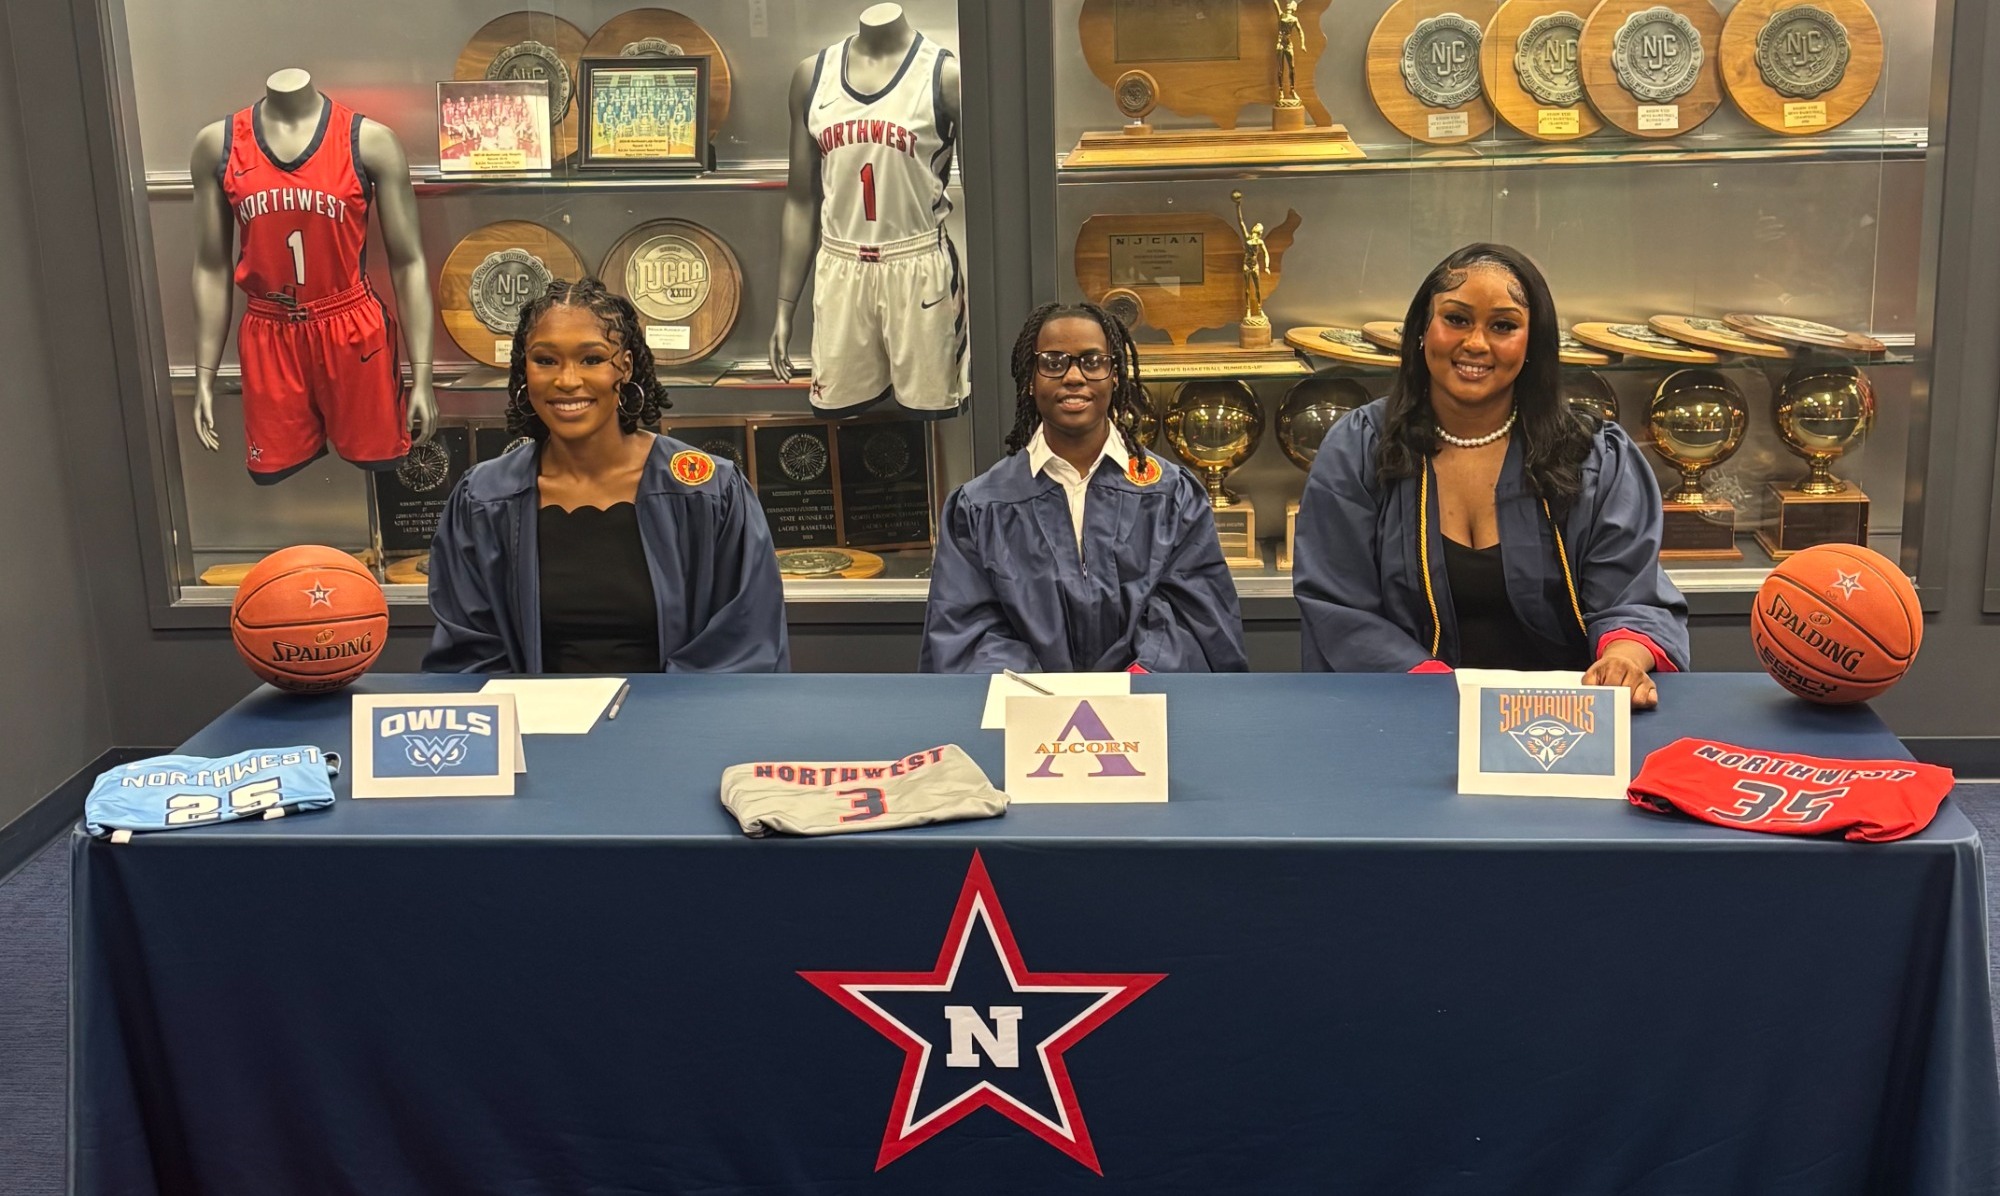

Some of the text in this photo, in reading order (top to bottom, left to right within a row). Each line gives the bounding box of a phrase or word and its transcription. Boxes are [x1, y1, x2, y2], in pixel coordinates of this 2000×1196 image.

[817, 119, 918, 160] NORTHWEST
[238, 187, 346, 225] NORTHWEST
[860, 162, 877, 222] 1
[286, 229, 306, 286] 1
[637, 260, 704, 295] NJCAA
[670, 287, 692, 298] XXIII
[271, 631, 373, 663] SPALDING
[1765, 593, 1865, 675] SPALDING
[1756, 632, 1838, 695] LEGACY
[380, 708, 492, 738] OWLS
[1499, 693, 1595, 734] SKYHAWKS
[120, 748, 319, 788] NORTHWEST
[754, 746, 945, 787] NORTHWEST
[1034, 741, 1140, 754] ALCORN
[165, 776, 282, 826] 25
[837, 787, 889, 823] 3
[1705, 779, 1851, 824] 35
[943, 1005, 1023, 1068] N
